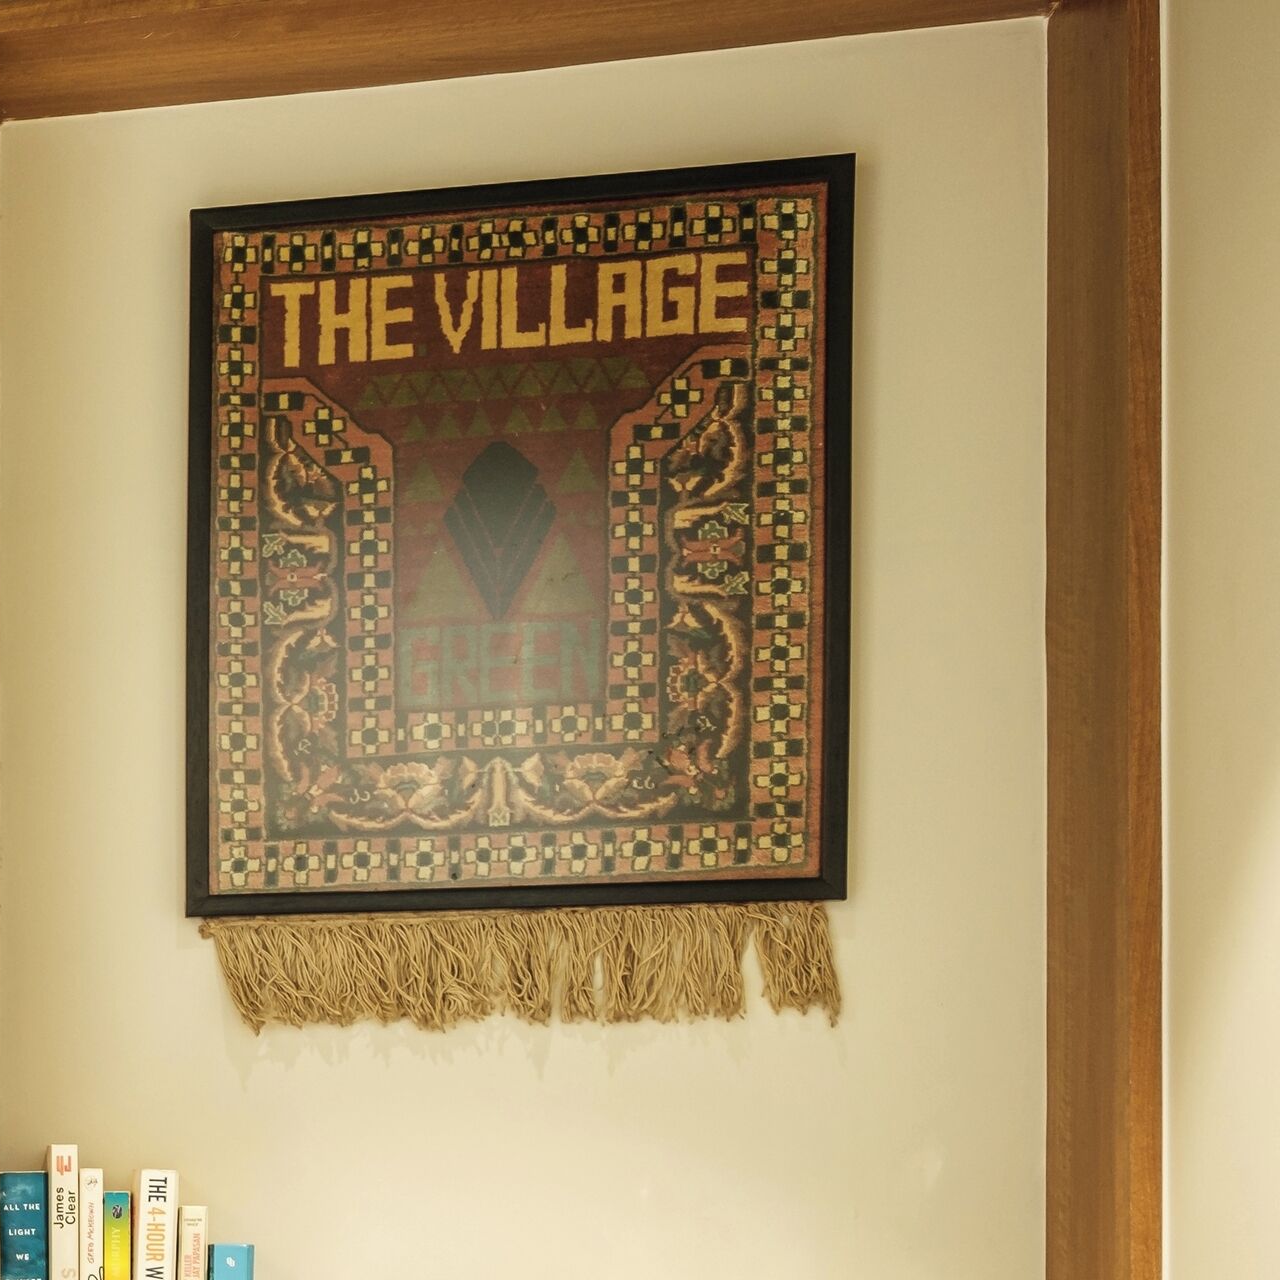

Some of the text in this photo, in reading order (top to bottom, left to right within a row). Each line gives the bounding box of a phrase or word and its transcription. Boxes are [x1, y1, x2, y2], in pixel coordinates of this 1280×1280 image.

[269, 252, 748, 367] THE VILLAGE
[399, 619, 601, 706] GREEN
[148, 1176, 168, 1202] THE
[3, 1203, 41, 1211] ALL THE
[53, 1186, 65, 1229] James
[65, 1189, 76, 1225] Clear
[8, 1228, 36, 1236] LIGHT
[145, 1207, 167, 1261] 4-HOUR
[15, 1253, 30, 1261] WE
[192, 1265, 200, 1279] JAY
